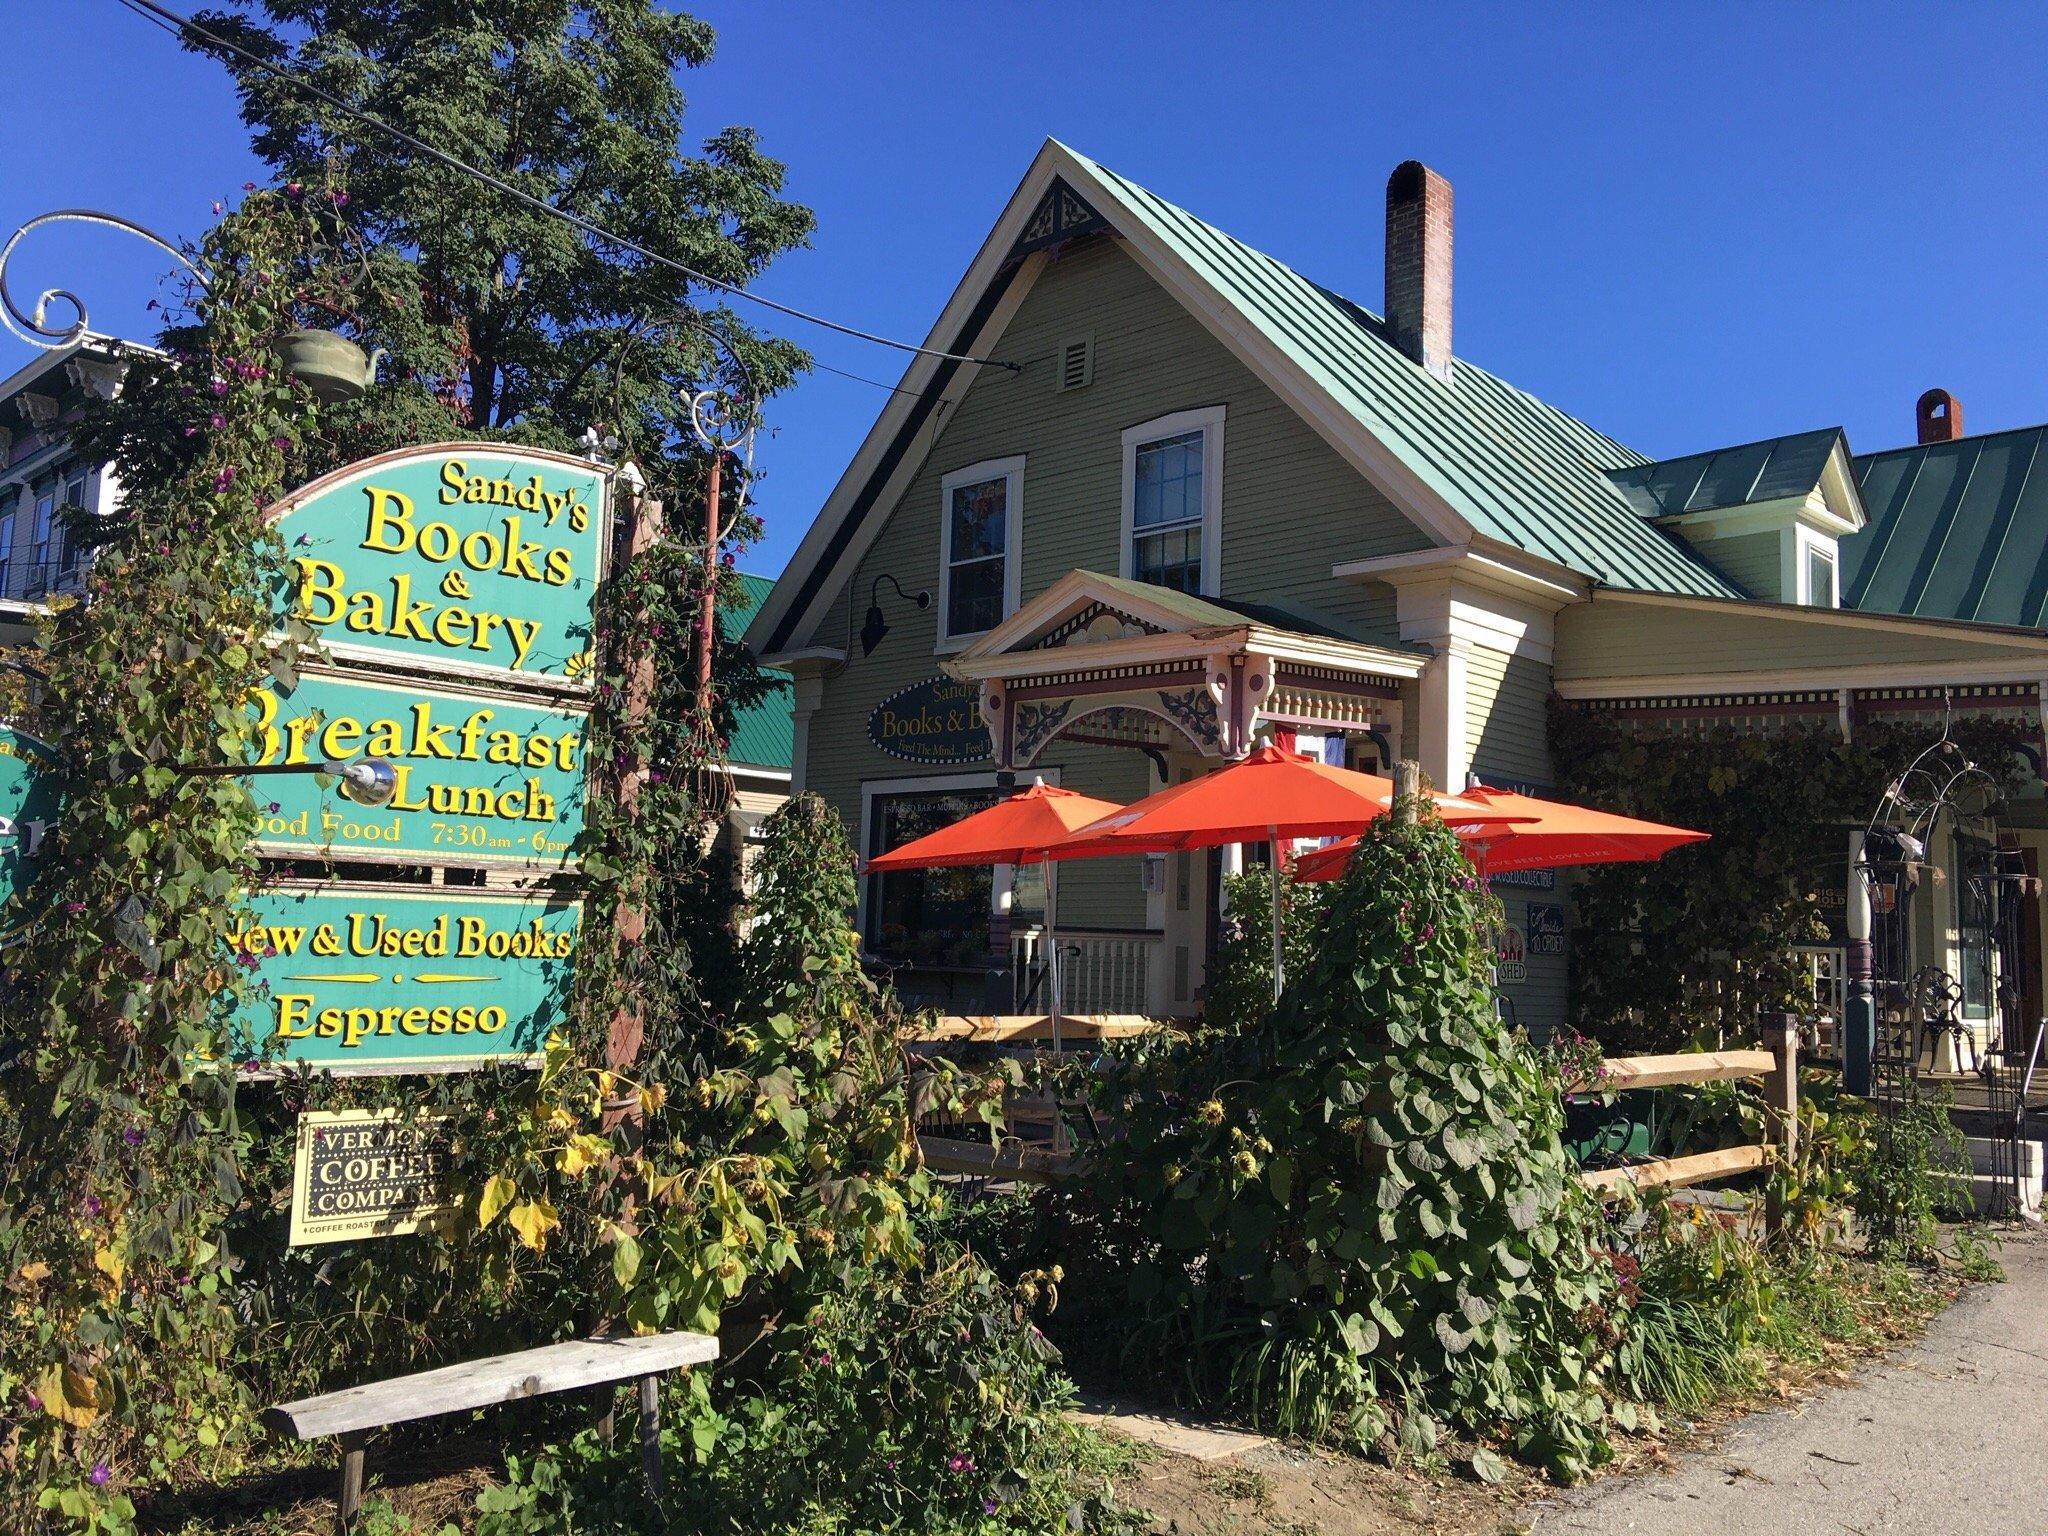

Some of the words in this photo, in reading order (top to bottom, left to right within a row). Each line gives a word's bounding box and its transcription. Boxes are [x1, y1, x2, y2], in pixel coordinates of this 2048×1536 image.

[440, 458, 589, 533] Sandy's
[359, 485, 573, 587] Books
[440, 569, 474, 600] &
[294, 556, 543, 671] Bakery
[881, 704, 944, 738] Books
[947, 709, 966, 732] &
[387, 764, 557, 823] Lunch
[321, 812, 401, 842] Food
[311, 922, 345, 958] &
[346, 911, 449, 958] Used
[456, 914, 572, 960] Books
[1500, 964, 1525, 980] SHED
[273, 992, 508, 1049] Espresso
[319, 1154, 445, 1185] COFFEE
[308, 1224, 344, 1234] COFFEE
[345, 1219, 386, 1230] ROASTED
